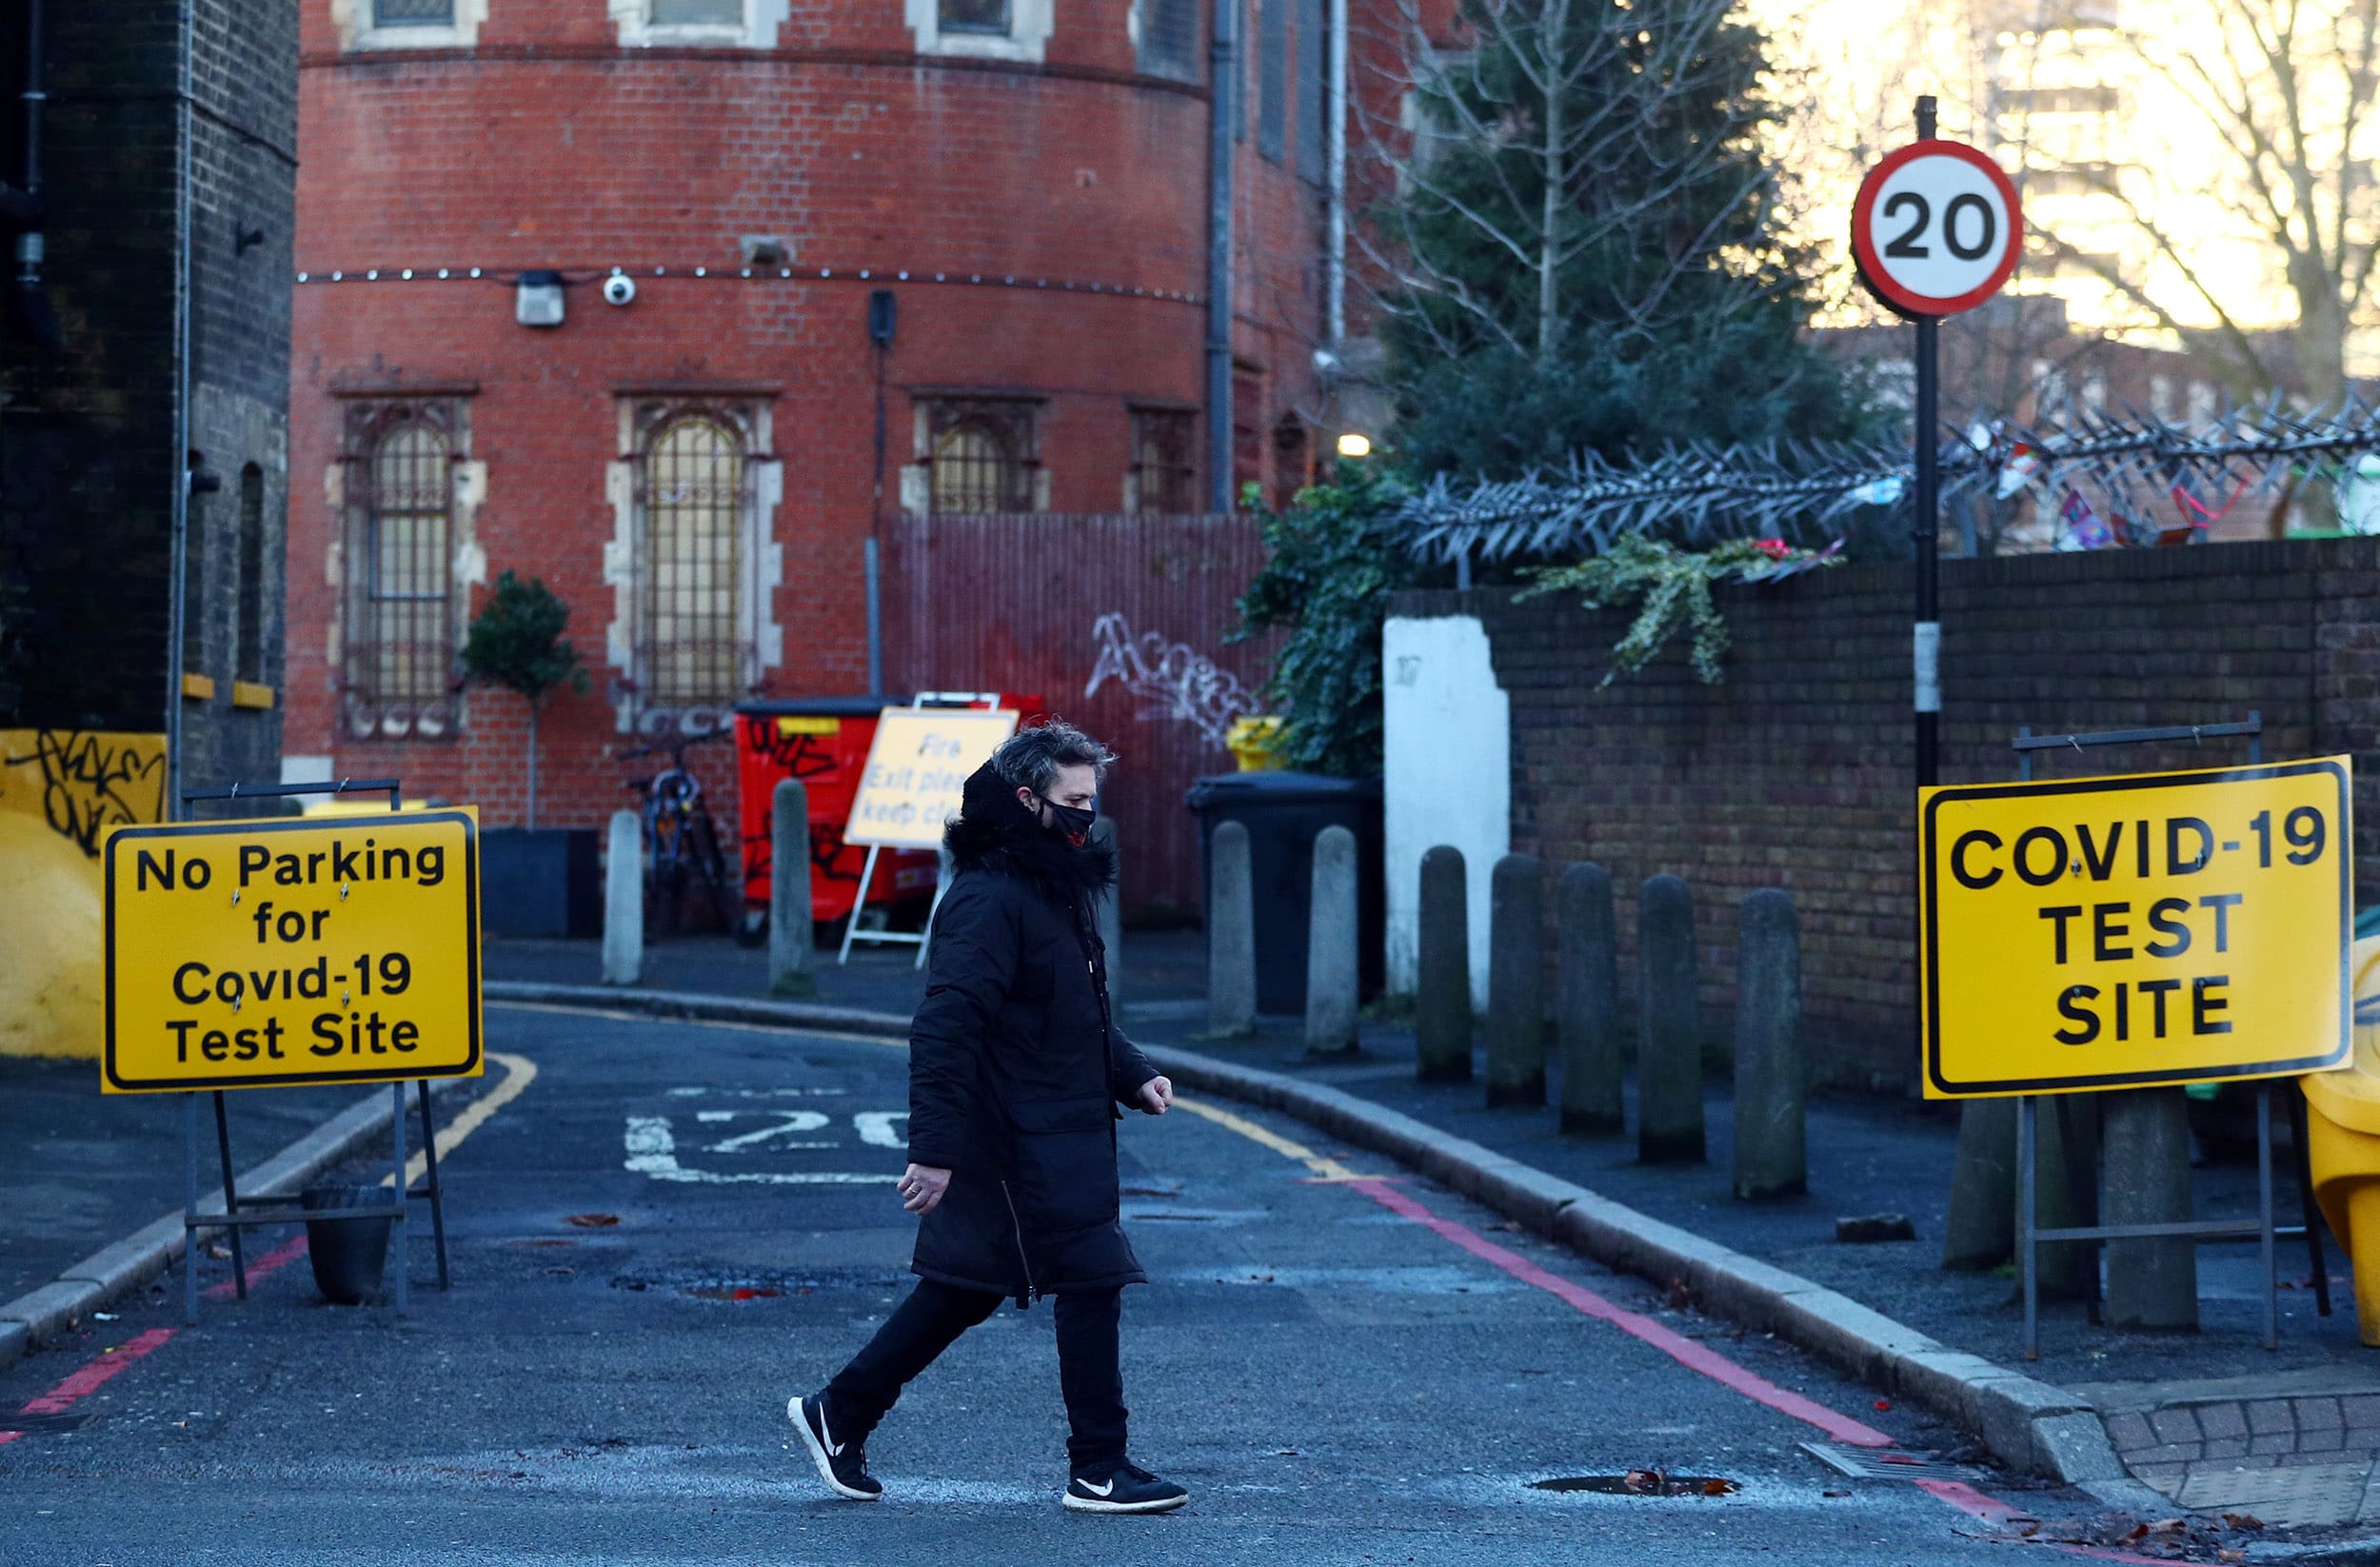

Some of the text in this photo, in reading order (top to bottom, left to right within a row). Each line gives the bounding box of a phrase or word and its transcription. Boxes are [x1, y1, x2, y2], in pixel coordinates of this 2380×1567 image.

[1884, 191, 1996, 261] 20
[137, 839, 446, 892] No Parking
[1950, 805, 2327, 890] COVID-19
[252, 901, 331, 943] for
[2038, 892, 2243, 965] TEST
[172, 952, 412, 1005] Covid-19
[165, 1011, 420, 1063] Test Site
[2053, 975, 2233, 1046] SITE
